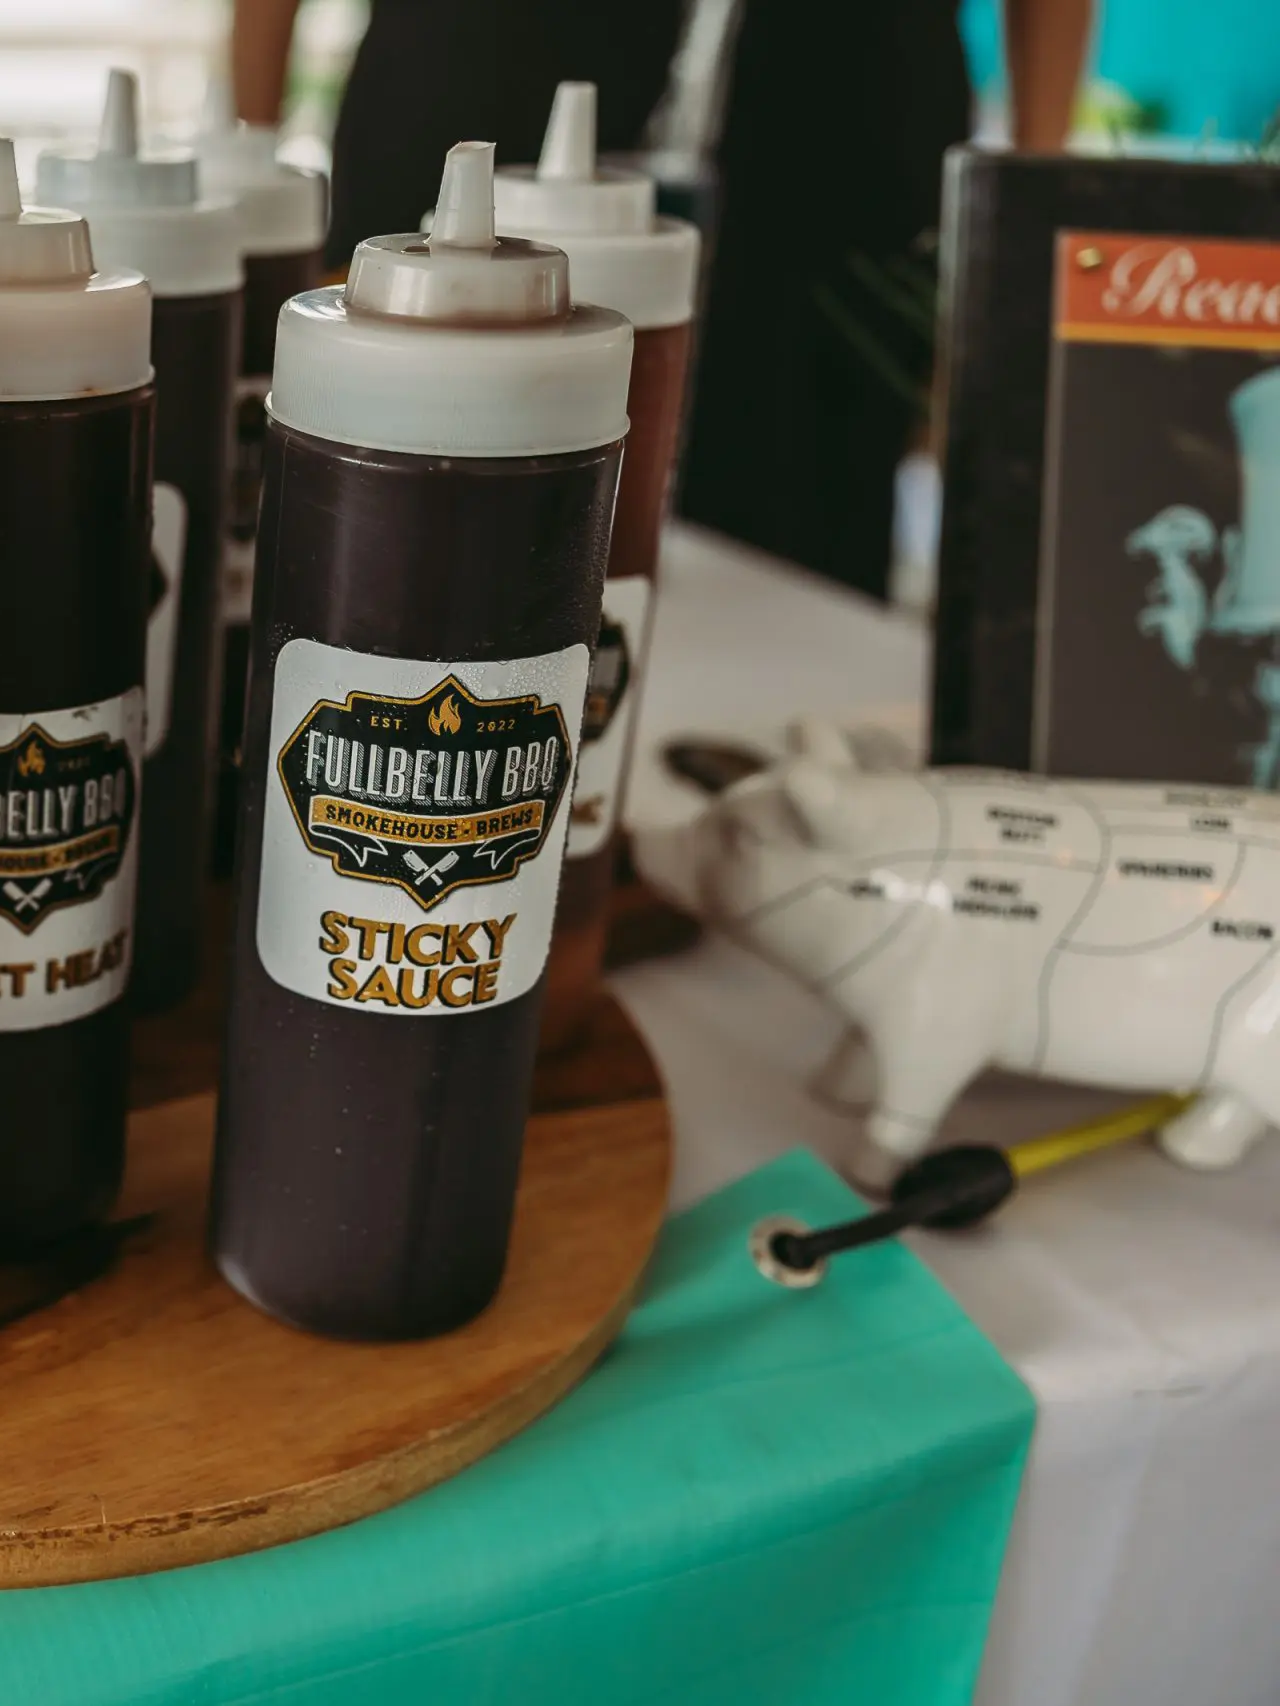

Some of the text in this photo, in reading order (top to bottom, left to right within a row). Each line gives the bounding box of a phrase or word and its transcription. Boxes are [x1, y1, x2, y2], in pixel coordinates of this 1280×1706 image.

[370, 715, 516, 733] EST. 2022
[305, 729, 560, 806] FULLBELLY BBQ
[325, 803, 533, 840] SMOKEHOUSE BREWS
[319, 910, 517, 966] STICKY
[327, 957, 501, 1010] SAUCE
